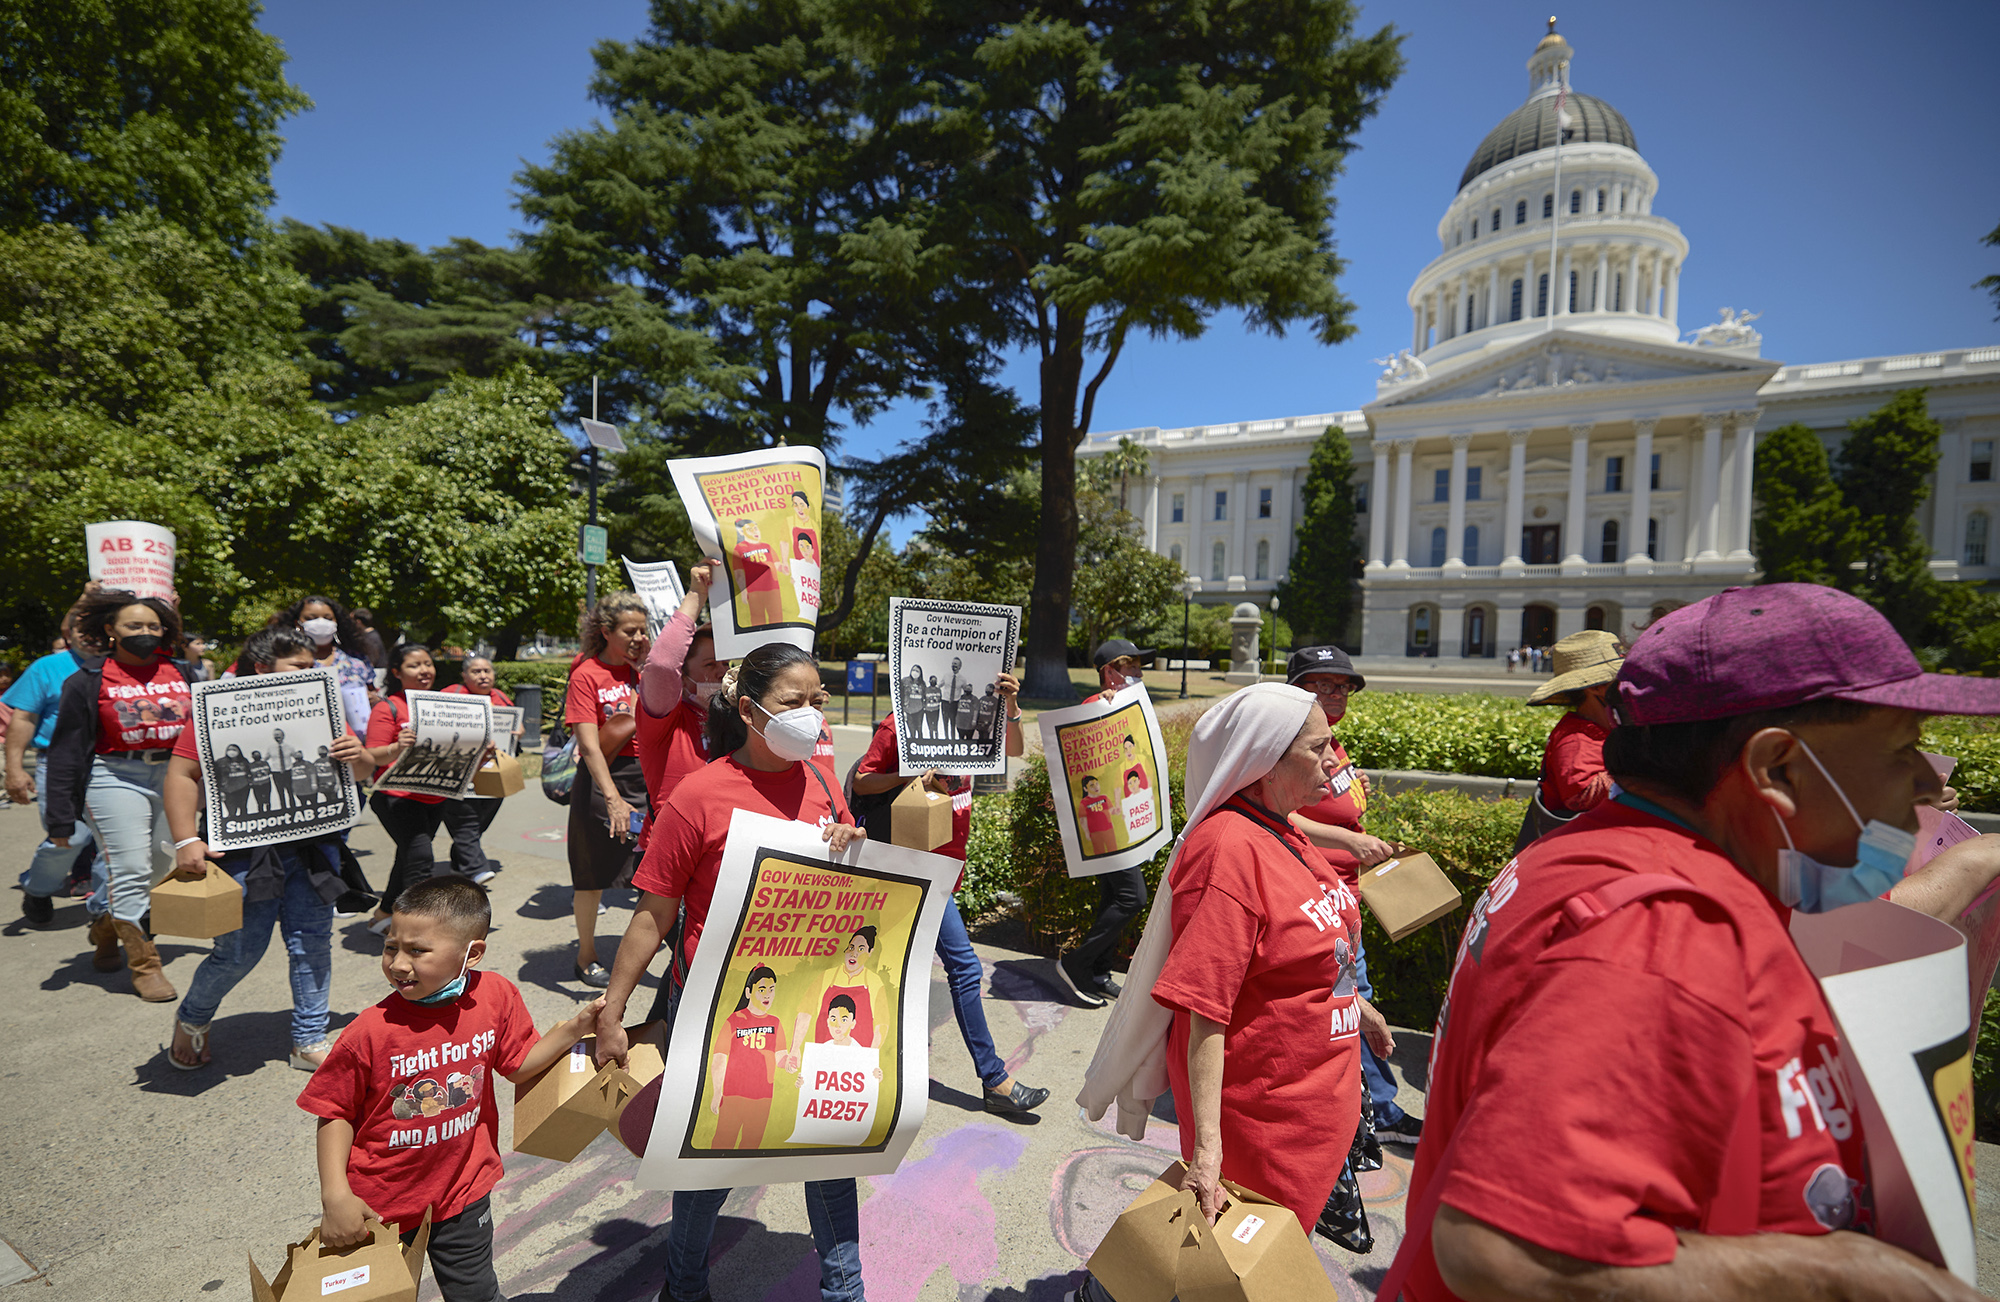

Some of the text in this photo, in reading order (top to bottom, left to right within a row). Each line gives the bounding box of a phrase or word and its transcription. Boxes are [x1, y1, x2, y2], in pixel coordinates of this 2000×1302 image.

[703, 468, 768, 487] GOV NEWSOM:
[707, 471, 802, 497] STAND WITH
[711, 484, 795, 508] FAST FOOD
[716, 498, 787, 517] FAMILIES
[100, 537, 133, 553] AB
[801, 592, 820, 609] AB2
[926, 614, 983, 626] Gov Newsom:
[906, 623, 1003, 641] Be a champion of
[903, 636, 1002, 655] fast food workers
[107, 680, 189, 699] Fight For $1
[234, 687, 298, 701] Gov Newsom:
[598, 684, 626, 703] Fight
[212, 693, 322, 717] Be a champion of
[211, 706, 325, 730] fast food workers
[420, 718, 435, 726] fast
[436, 719, 453, 727] food
[456, 721, 484, 729] workers
[438, 710, 473, 720] champion
[1061, 719, 1110, 741] GOV NEWSOM:
[1064, 716, 1129, 753] STAND WITH
[910, 742, 993, 758] Support AB 257
[1066, 732, 1126, 765] FAST FOOD
[1068, 749, 1121, 777] FAMILIES
[440, 778, 460, 789] 257
[225, 801, 345, 834] Support AB 257
[1129, 801, 1150, 818] PASS
[1129, 812, 1153, 831] AB257
[760, 870, 854, 889] GOV NEWSOM:
[754, 888, 888, 912] STAND WITH
[745, 912, 865, 934] FAST FOOD
[1299, 897, 1342, 933] Fig
[735, 937, 840, 958] FAMILIES
[736, 1026, 773, 1038] FIGHT FOR
[742, 1032, 766, 1050] $15
[390, 1029, 496, 1078] Fight For $15
[814, 1070, 866, 1093] PASS
[1776, 1043, 1855, 1142] Figh
[802, 1098, 869, 1123] AB257
[388, 1105, 481, 1148] AND A UNIO
[324, 1277, 347, 1289] Turkey
